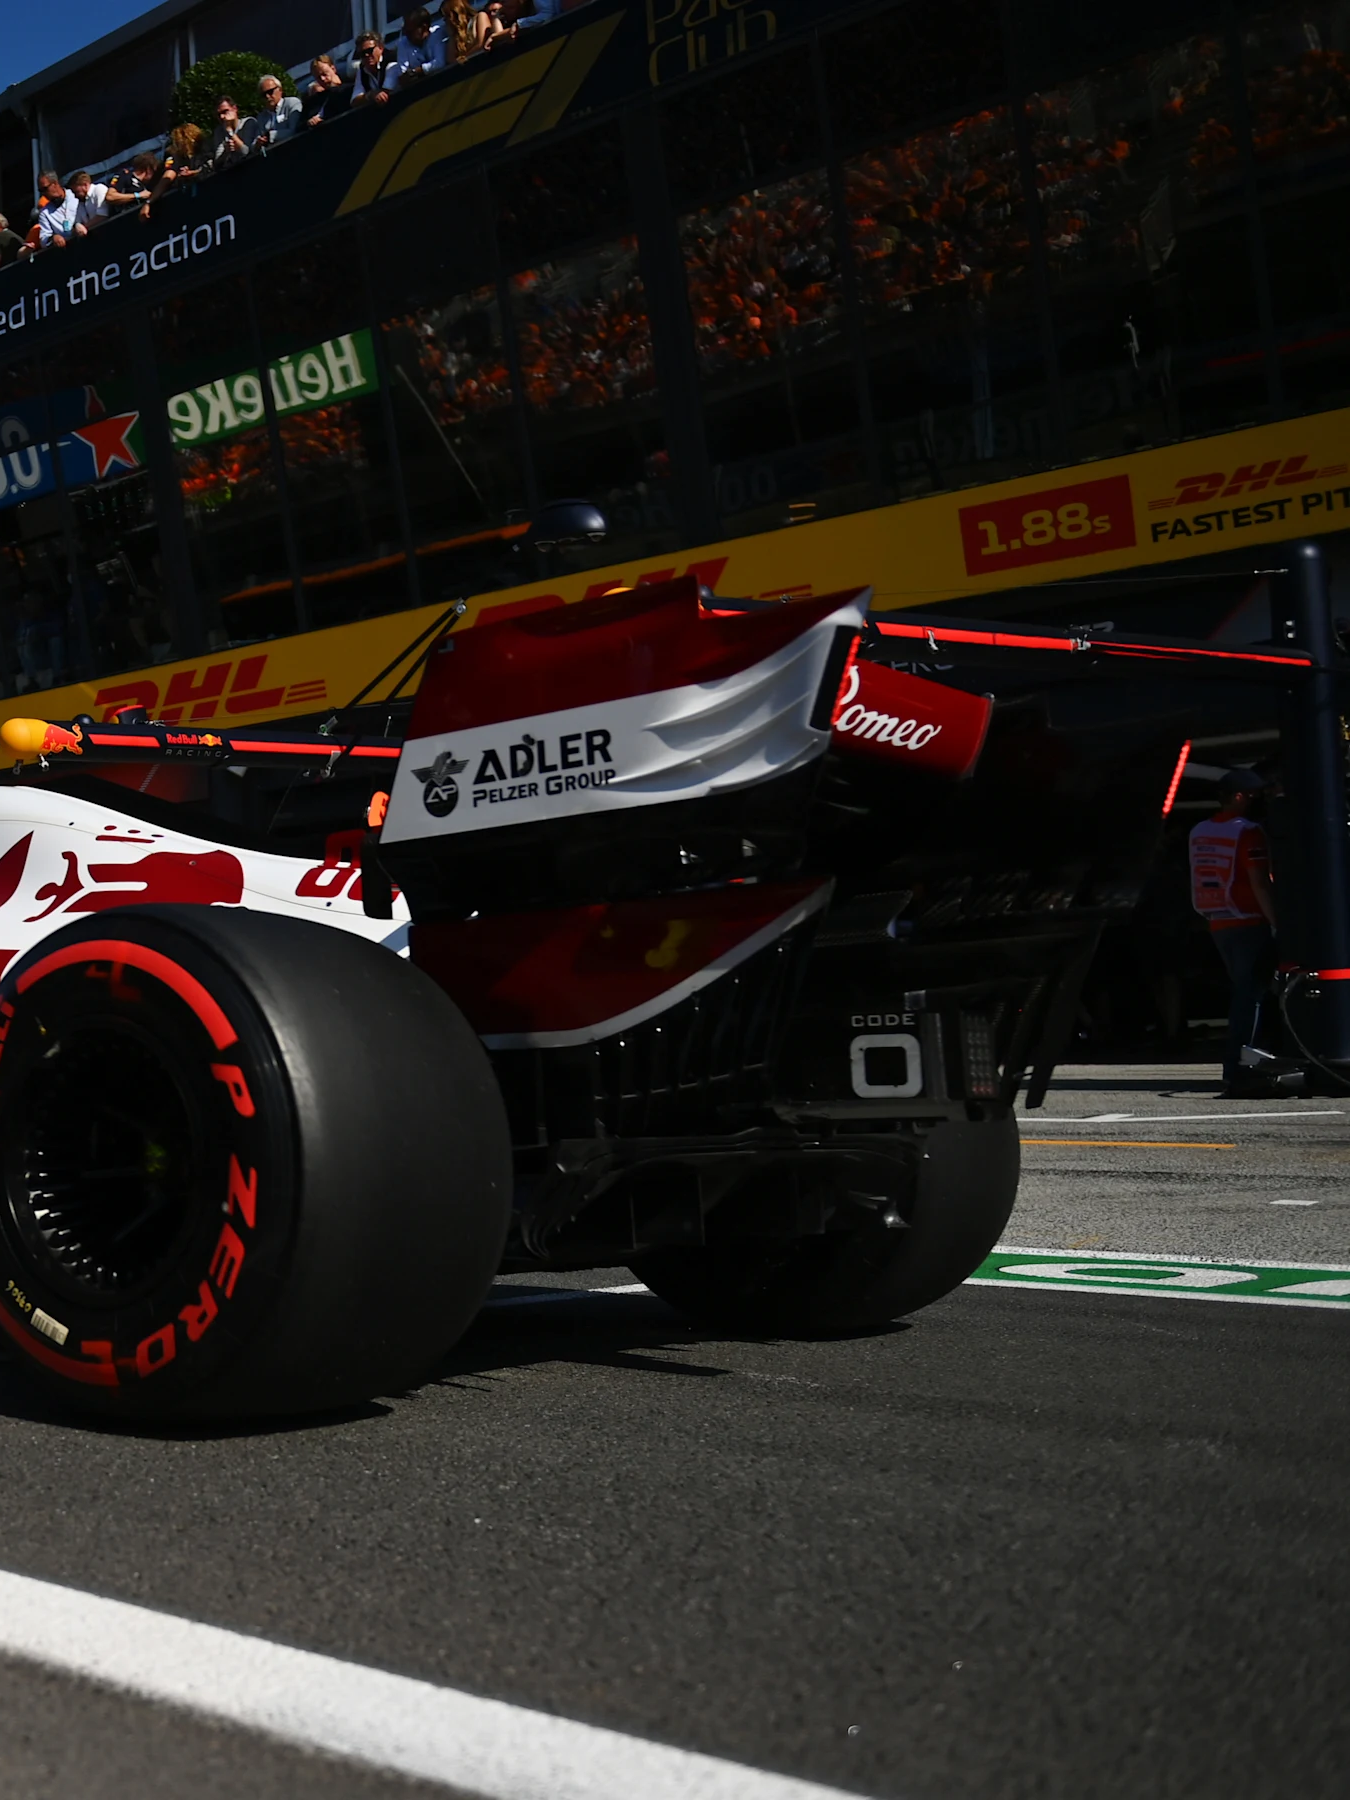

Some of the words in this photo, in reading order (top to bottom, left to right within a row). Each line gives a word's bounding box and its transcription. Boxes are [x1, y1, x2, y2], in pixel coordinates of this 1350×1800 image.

[34, 288, 60, 321] in
[67, 262, 121, 305] the
[130, 213, 237, 280] action
[1174, 455, 1319, 506] DHL
[977, 502, 1112, 556] 1.88s
[1151, 498, 1293, 542] FASTEST
[1301, 487, 1350, 516] PIT
[94, 654, 286, 725] DHL
[165, 748, 222, 758] RACING
[473, 729, 612, 785] ADLER
[473, 783, 538, 807] PELZER
[546, 769, 615, 795] GROUP
[851, 1013, 916, 1027] CODE
[210, 1062, 256, 1118] P
[137, 1152, 258, 1379] ZERO
